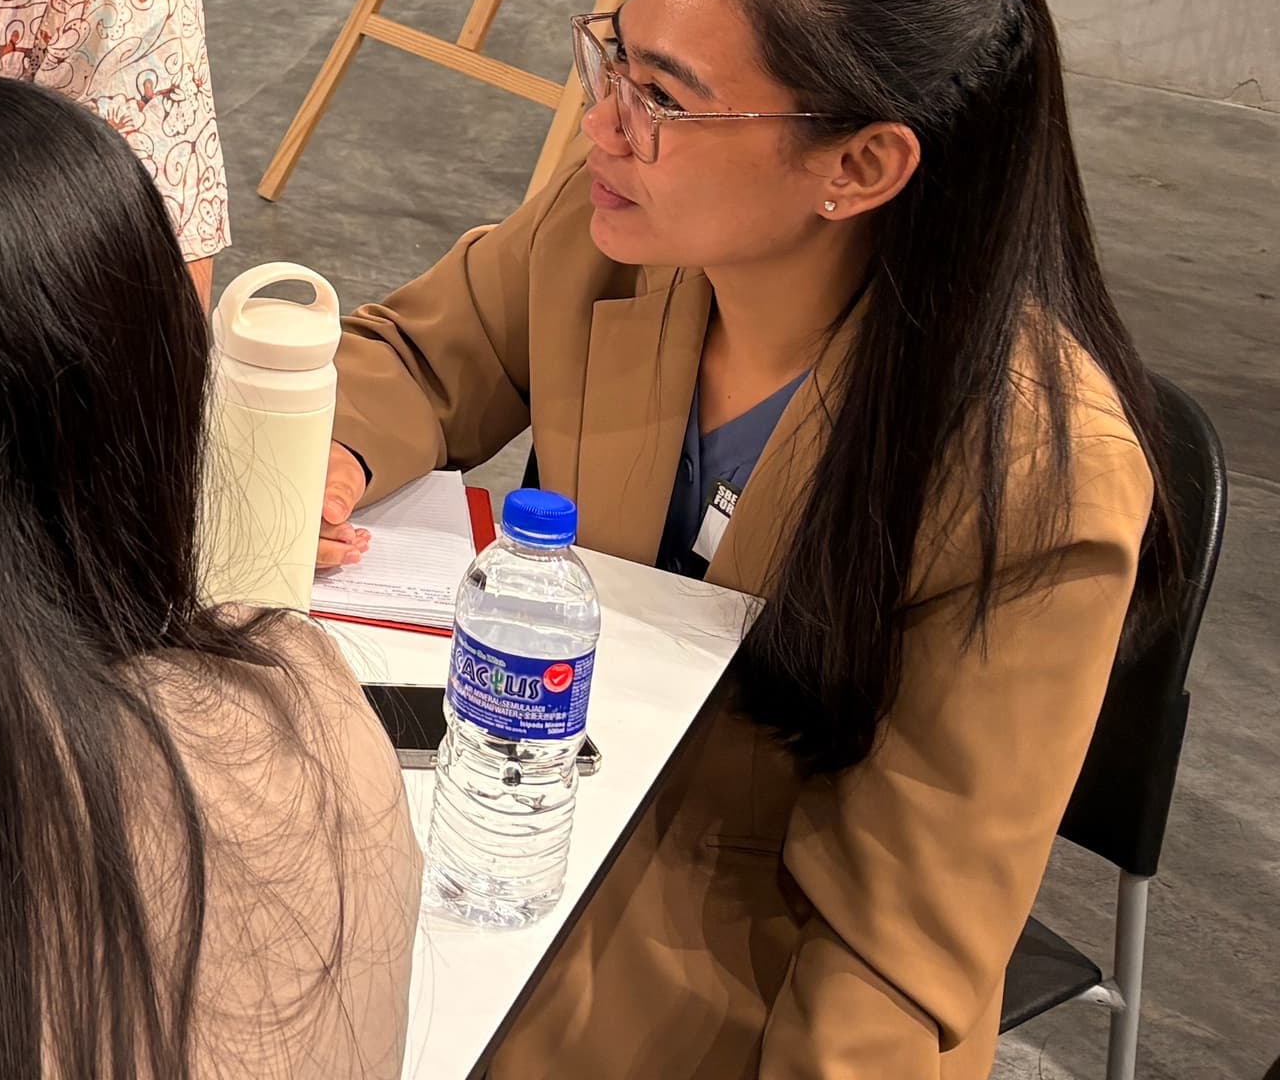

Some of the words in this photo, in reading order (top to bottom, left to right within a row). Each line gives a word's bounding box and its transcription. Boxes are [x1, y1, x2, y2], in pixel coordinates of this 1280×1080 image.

[717, 485, 738, 505] SBE
[473, 688, 501, 706] MINERAL
[502, 699, 546, 713] SEMULAJADI
